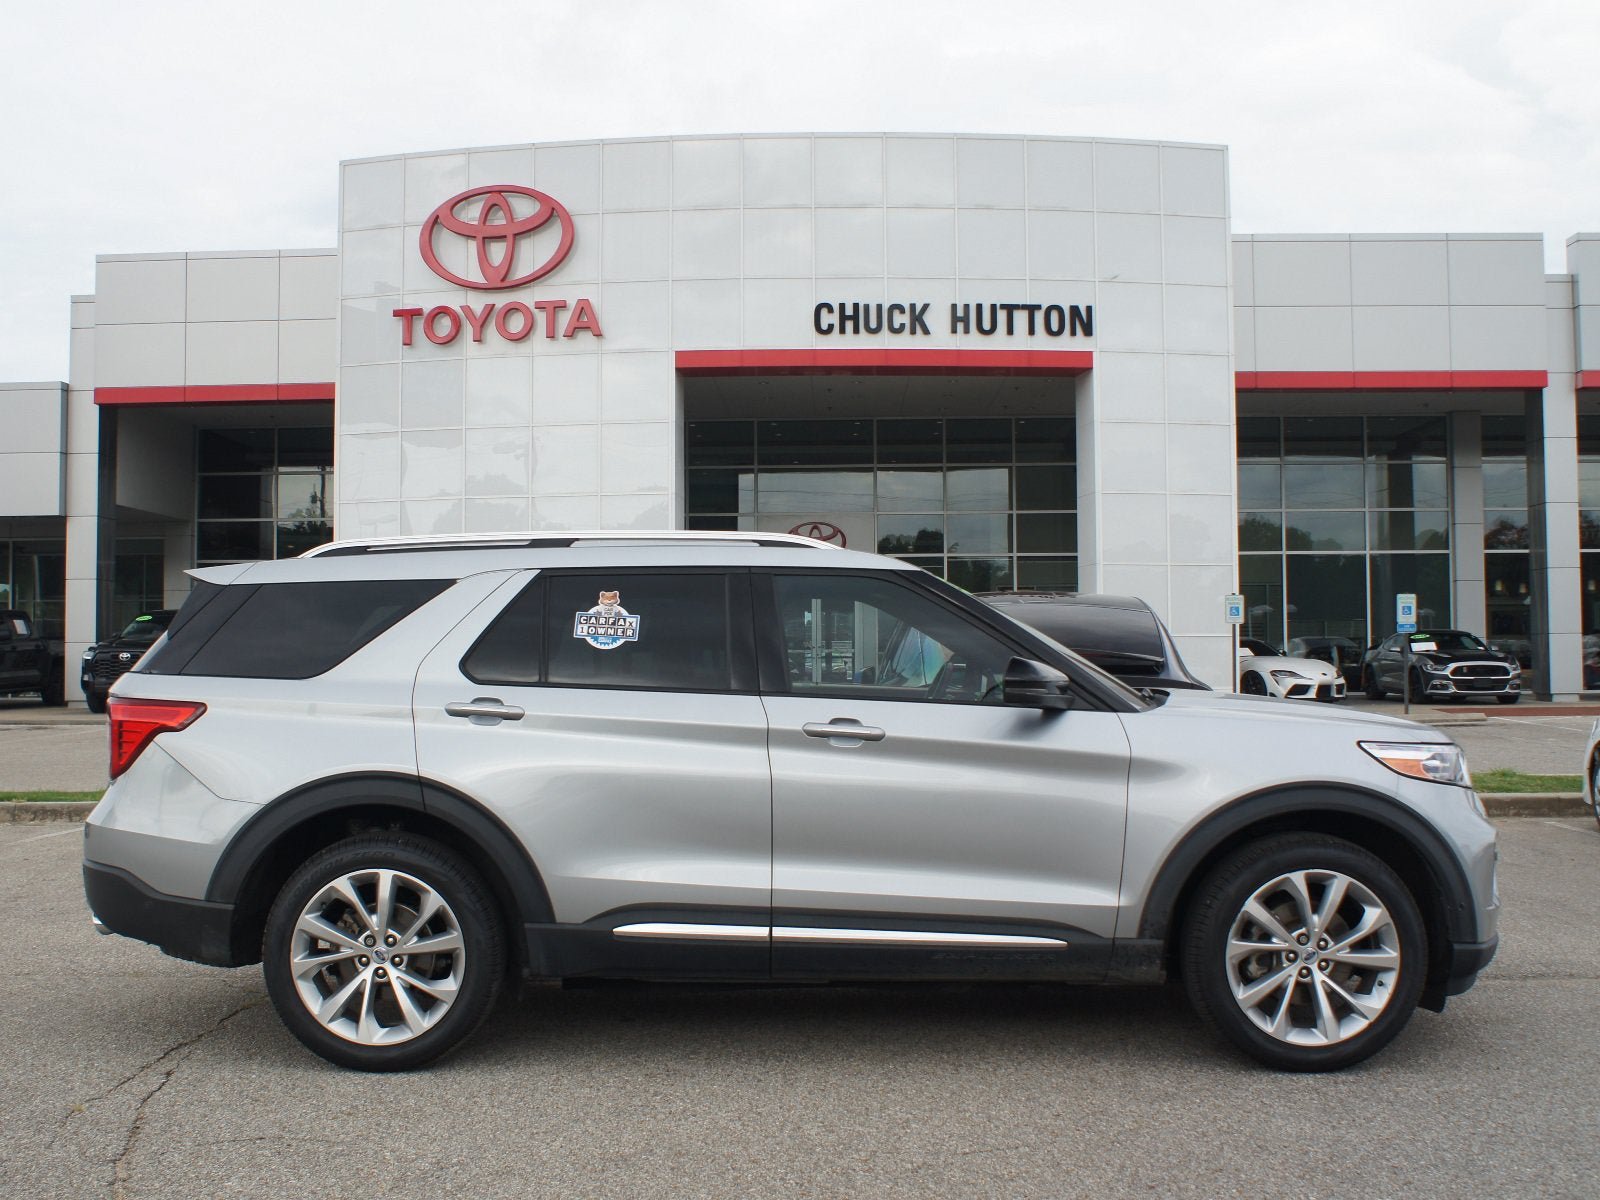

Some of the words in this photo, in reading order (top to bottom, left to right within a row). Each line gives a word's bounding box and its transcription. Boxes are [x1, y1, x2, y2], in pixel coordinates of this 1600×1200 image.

[393, 299, 603, 346] TOYOTA
[813, 302, 931, 335] CHUCK
[951, 303, 1093, 337] HUTTON
[580, 616, 634, 627] CARFAX
[588, 627, 634, 637] OWNER
